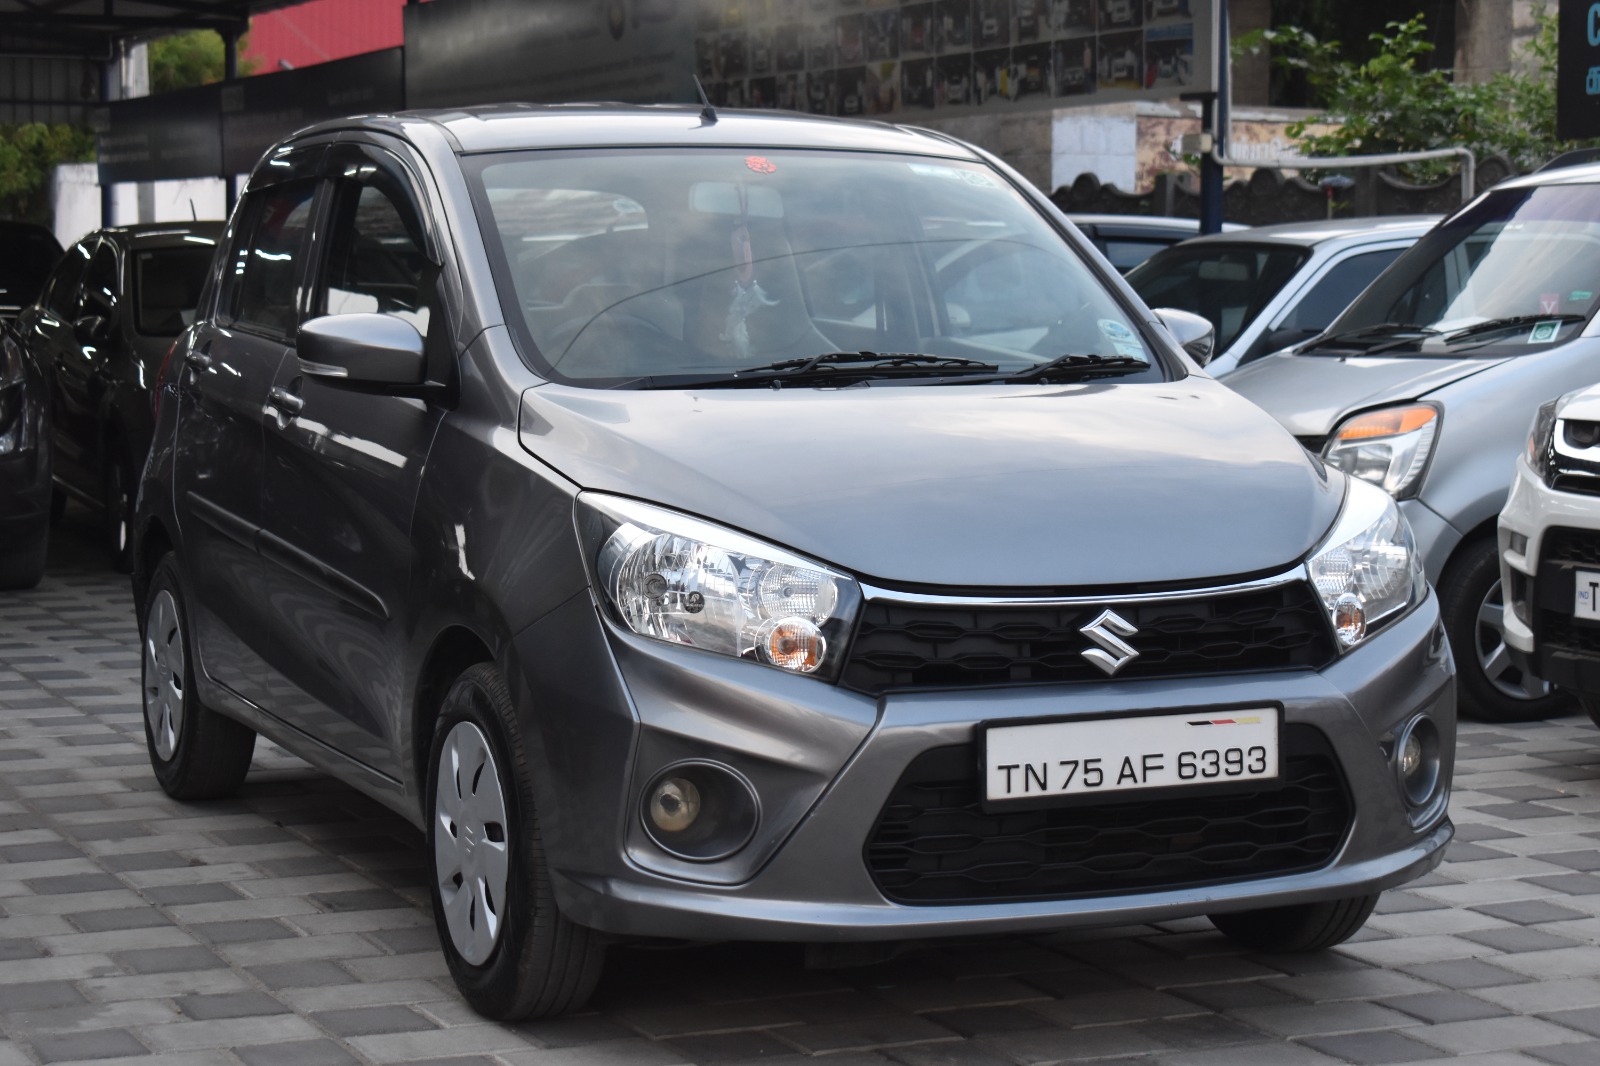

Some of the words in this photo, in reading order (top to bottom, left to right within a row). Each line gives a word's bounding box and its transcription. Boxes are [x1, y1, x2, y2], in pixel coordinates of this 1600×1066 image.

[998, 762, 1048, 793] TN
[1060, 758, 1104, 790] 75
[1116, 753, 1165, 785] AF
[1177, 746, 1267, 780] 6393
